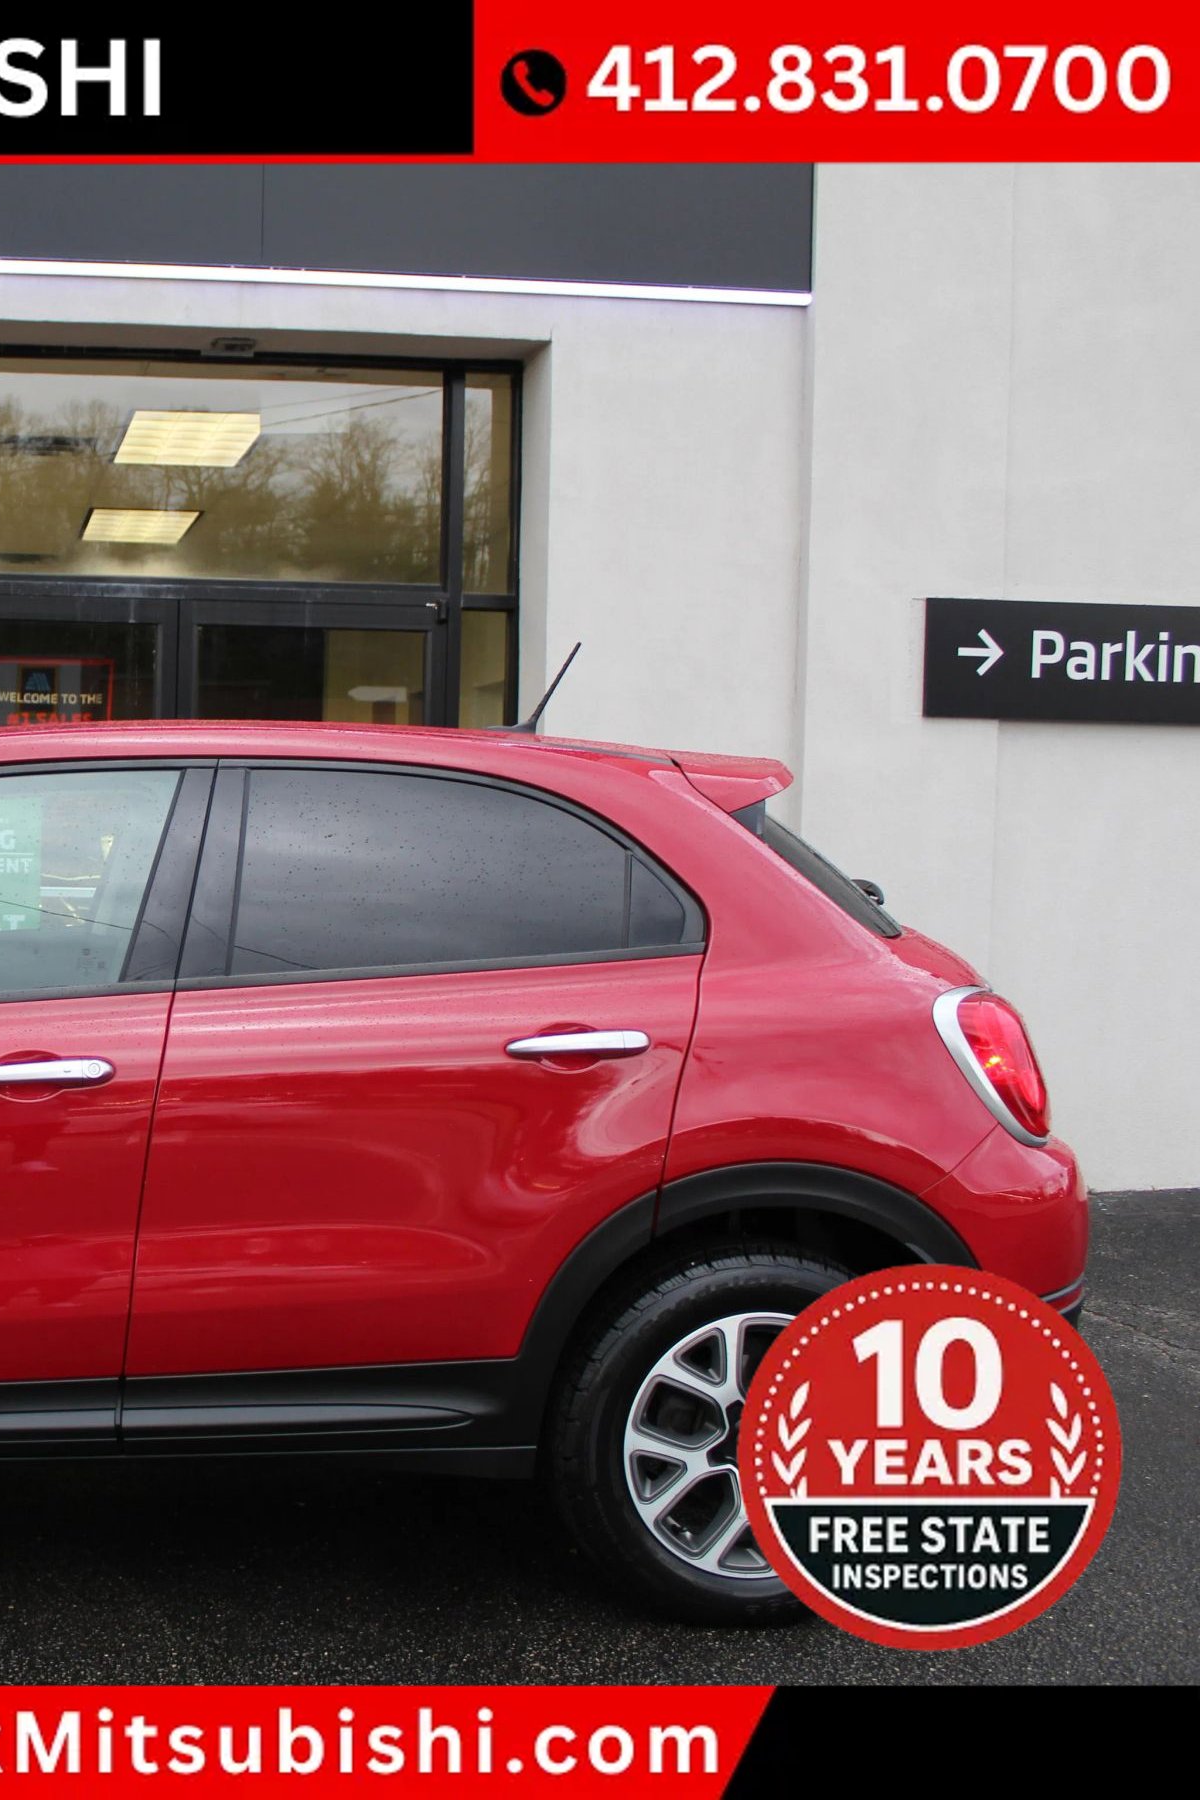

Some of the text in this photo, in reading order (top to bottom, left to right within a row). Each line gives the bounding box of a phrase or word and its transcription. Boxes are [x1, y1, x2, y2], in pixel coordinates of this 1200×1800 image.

[1031, 630, 1200, 683] Parkin
[61, 693, 77, 704] TO
[80, 693, 102, 704] THE
